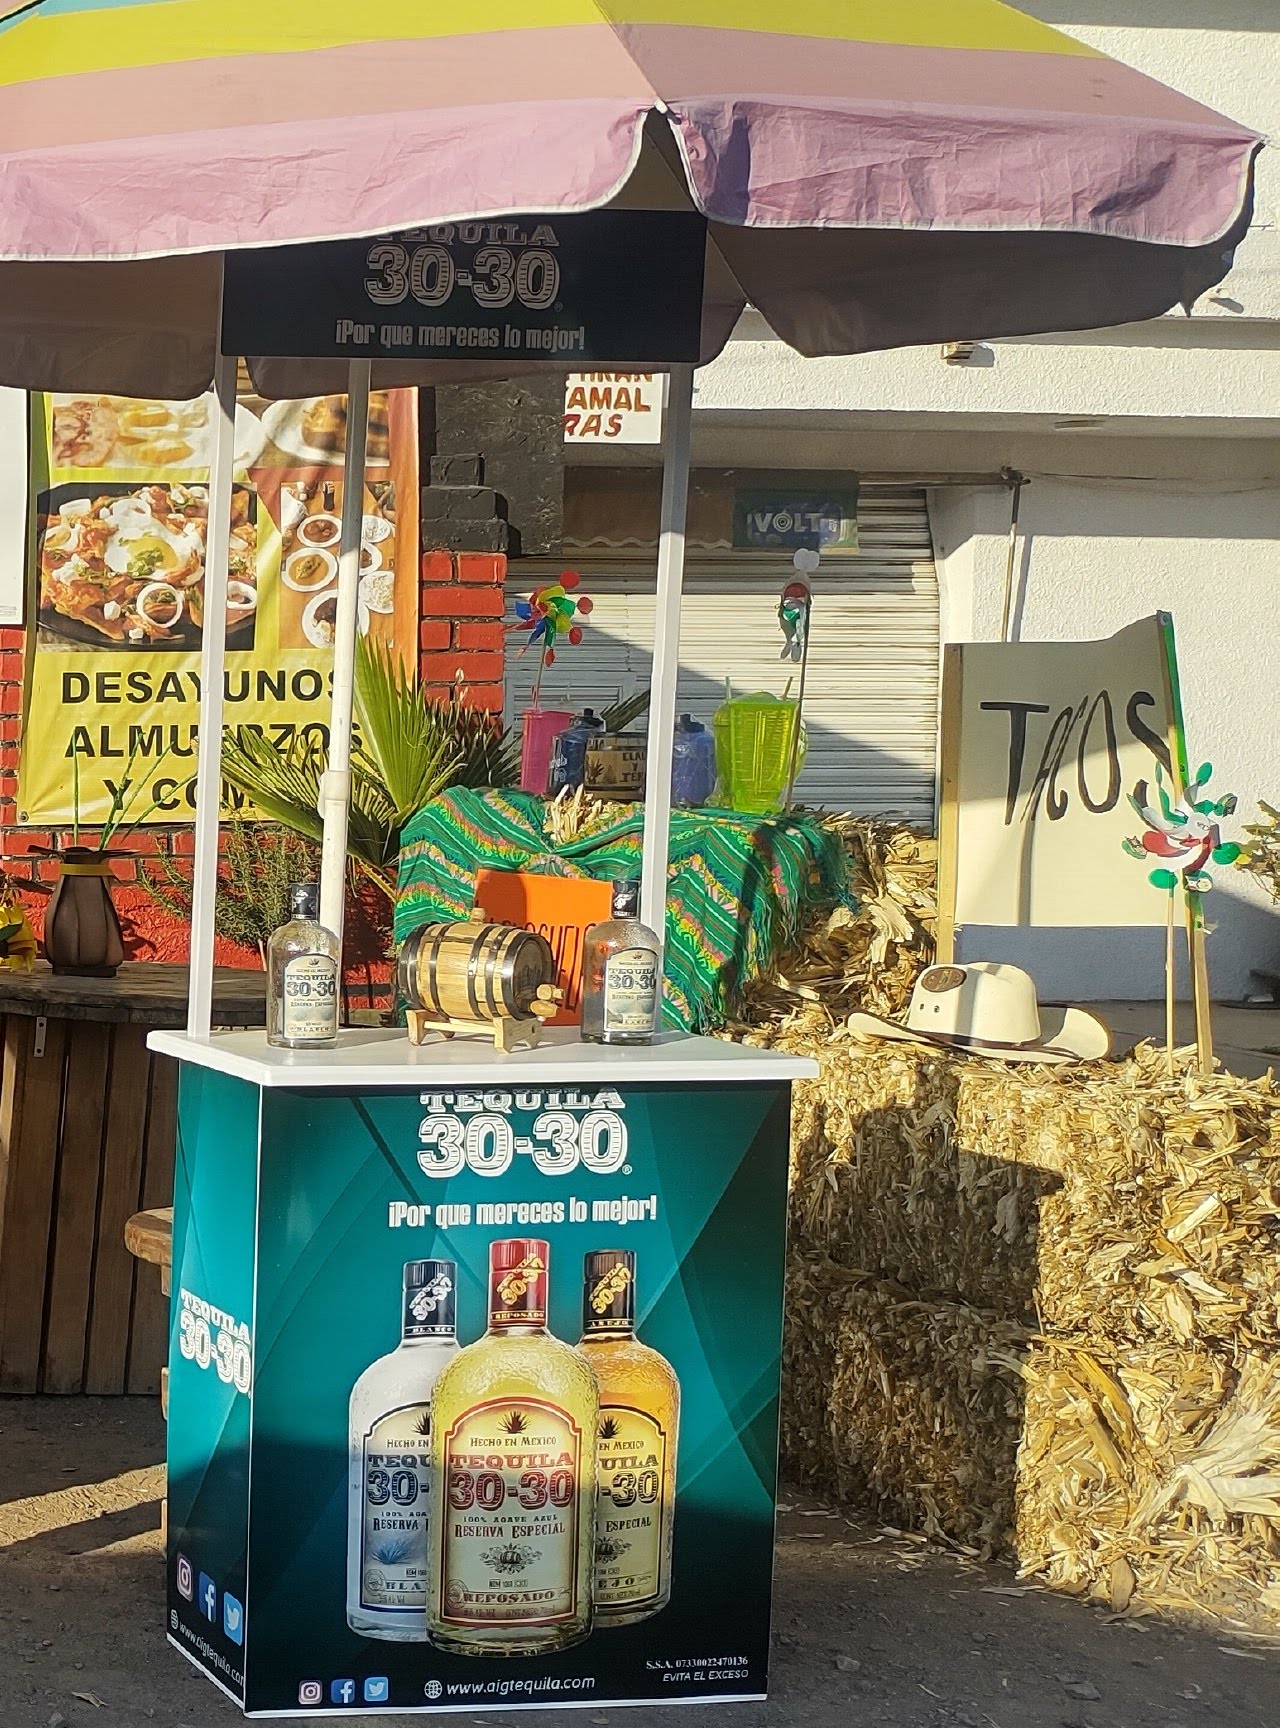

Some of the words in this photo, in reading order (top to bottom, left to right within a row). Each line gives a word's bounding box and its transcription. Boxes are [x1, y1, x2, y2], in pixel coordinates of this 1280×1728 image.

[377, 223, 560, 246] EQUILA
[364, 243, 560, 309] 30-30
[336, 320, 375, 345] ¡Por
[380, 324, 412, 348] que
[418, 325, 499, 347] mereces
[504, 324, 520, 348] lo
[525, 326, 585, 353] mejor!
[566, 387, 651, 412] AMAL
[754, 512, 824, 532] VOLT
[286, 981, 335, 996] 30-30
[420, 1087, 626, 1114] TEQUILA
[417, 1110, 628, 1178] 30-30
[389, 1201, 431, 1228] ¡Por
[436, 1202, 471, 1230] que
[476, 1201, 565, 1225] mereces
[569, 1196, 587, 1222] lo
[592, 1194, 657, 1225] mejor!
[180, 1287, 251, 1346] TEQUILA
[179, 1308, 252, 1394] 30-30
[387, 1439, 415, 1448] HECHO
[470, 1437, 502, 1447] HECHO
[504, 1438, 517, 1447] EN
[521, 1436, 557, 1446] MEXICO
[613, 1440, 644, 1450] MEXICO
[368, 1454, 430, 1468] TEQU
[449, 1452, 574, 1470] TEQUILA
[600, 1454, 659, 1470] UILA
[368, 1469, 429, 1506] 30-
[449, 1469, 575, 1511] 30-30
[598, 1469, 659, 1507] -30
[373, 1518, 419, 1531] RESERVA
[455, 1525, 503, 1538] RESERVA
[512, 1522, 565, 1539] ESPECIAL
[606, 1516, 651, 1532] ESPECIAL
[463, 1591, 555, 1603] REPOSADO
[663, 1672, 691, 1681] EVITA
[694, 1672, 706, 1680] EL
[708, 1669, 749, 1679] EXCESO
[447, 1675, 596, 1696] www.aigtequila.com
